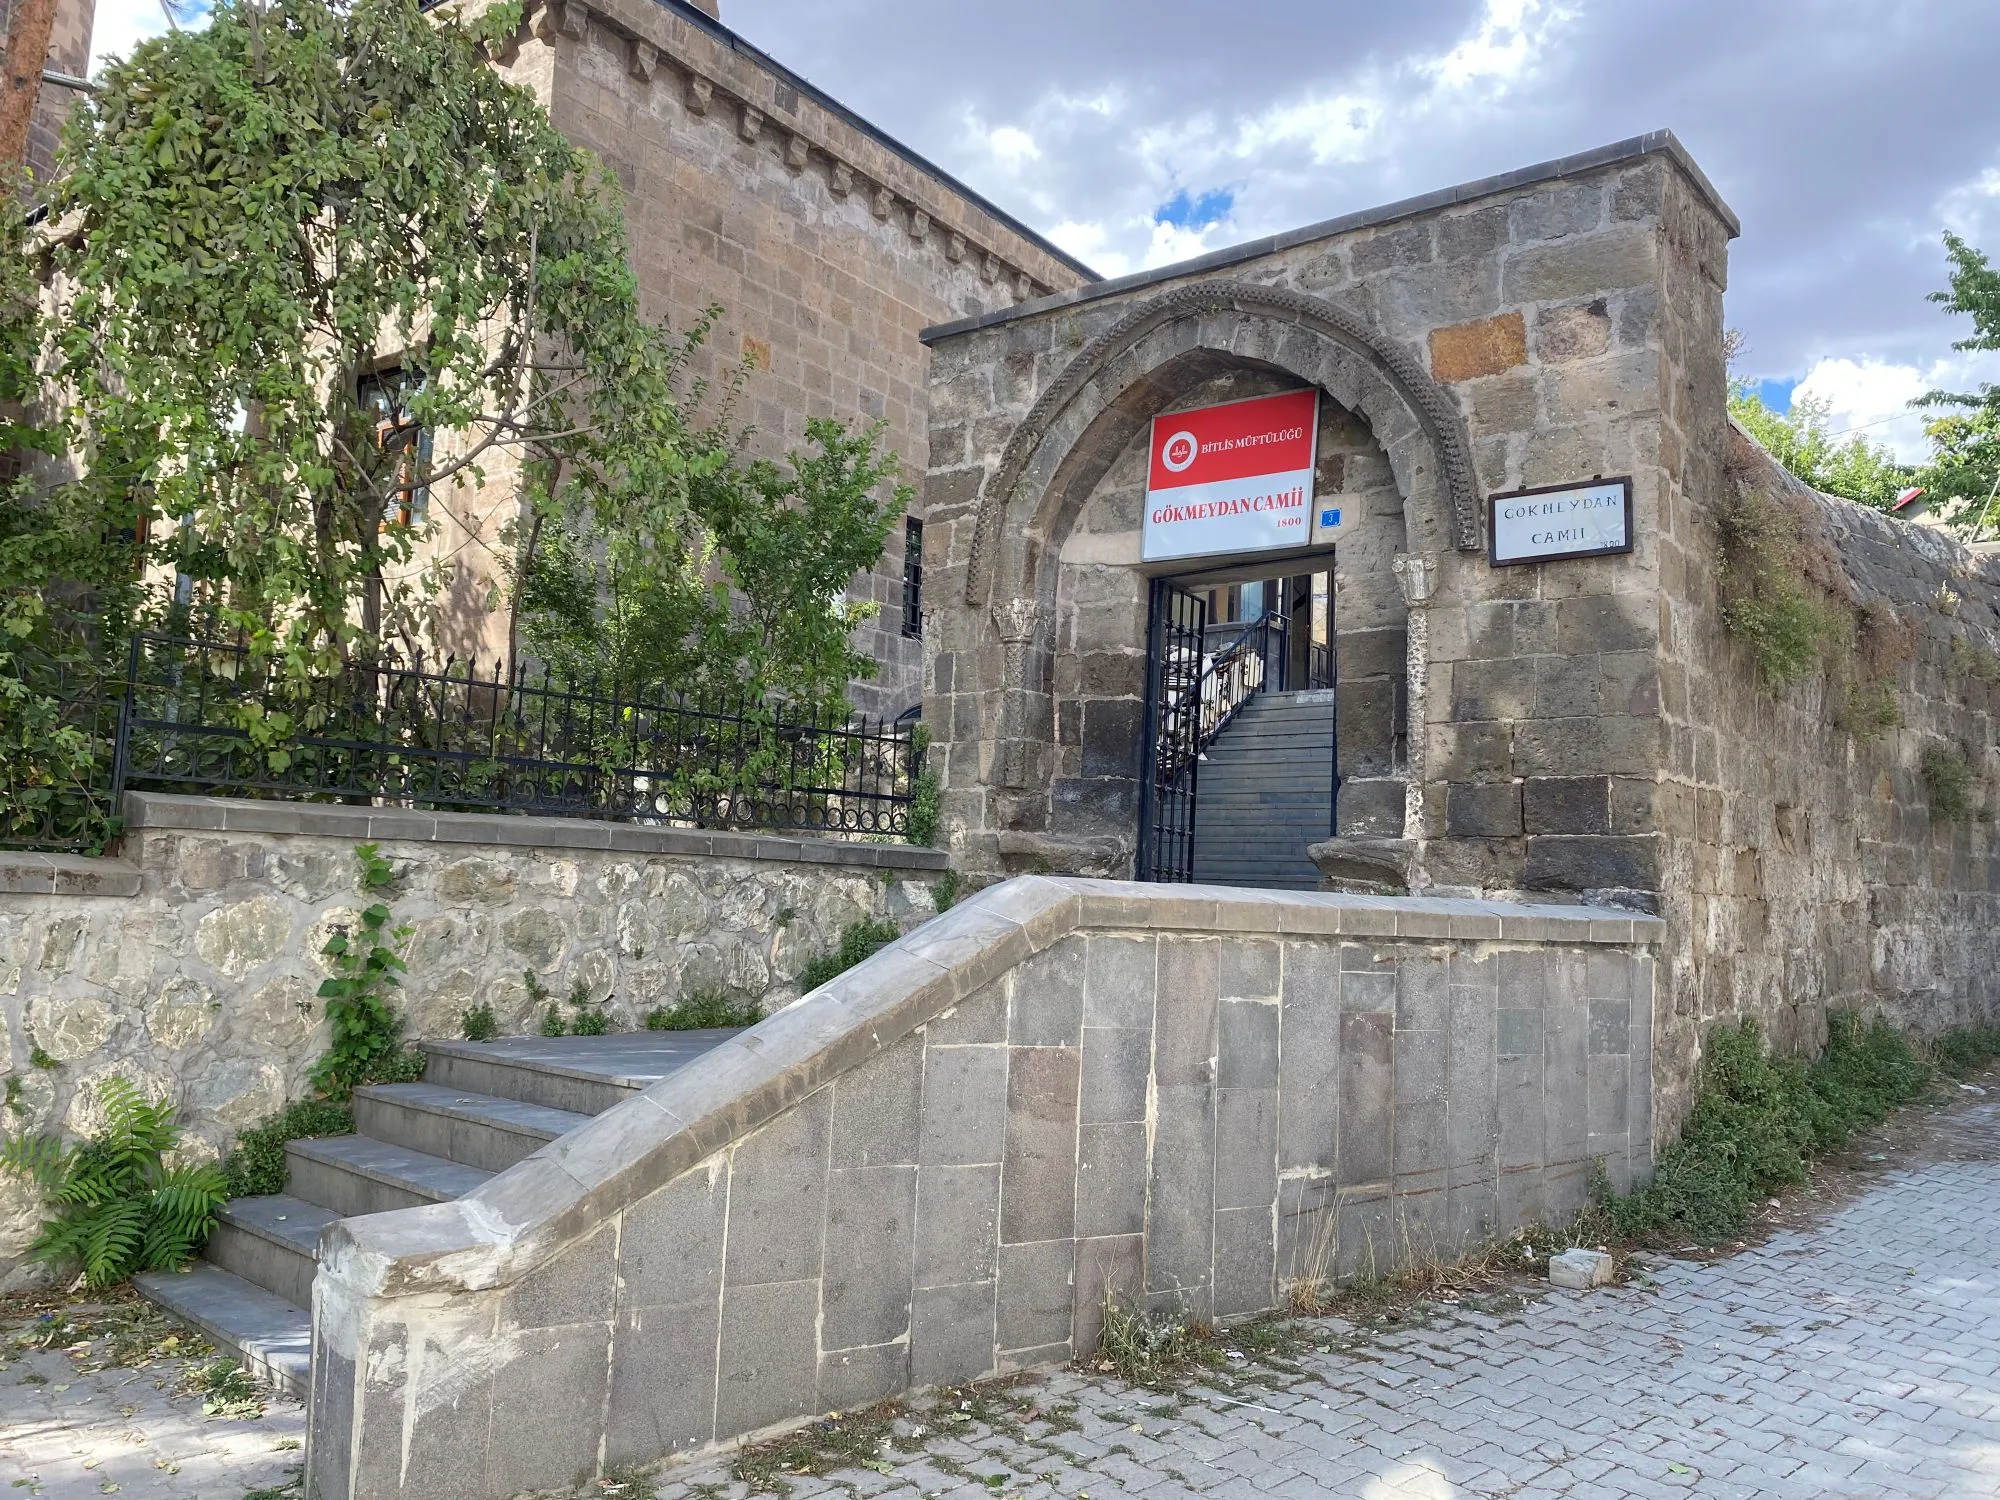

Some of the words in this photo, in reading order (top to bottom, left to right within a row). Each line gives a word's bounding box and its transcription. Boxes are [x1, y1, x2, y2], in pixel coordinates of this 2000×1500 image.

[1201, 438, 1234, 454] BİTLİS
[1234, 427, 1303, 449] MÜFTÜLÜĞÜ
[1152, 498, 1251, 524] GÖKMEYDAN
[1253, 486, 1304, 512] CAMİİ
[1276, 516, 1302, 528] 1800
